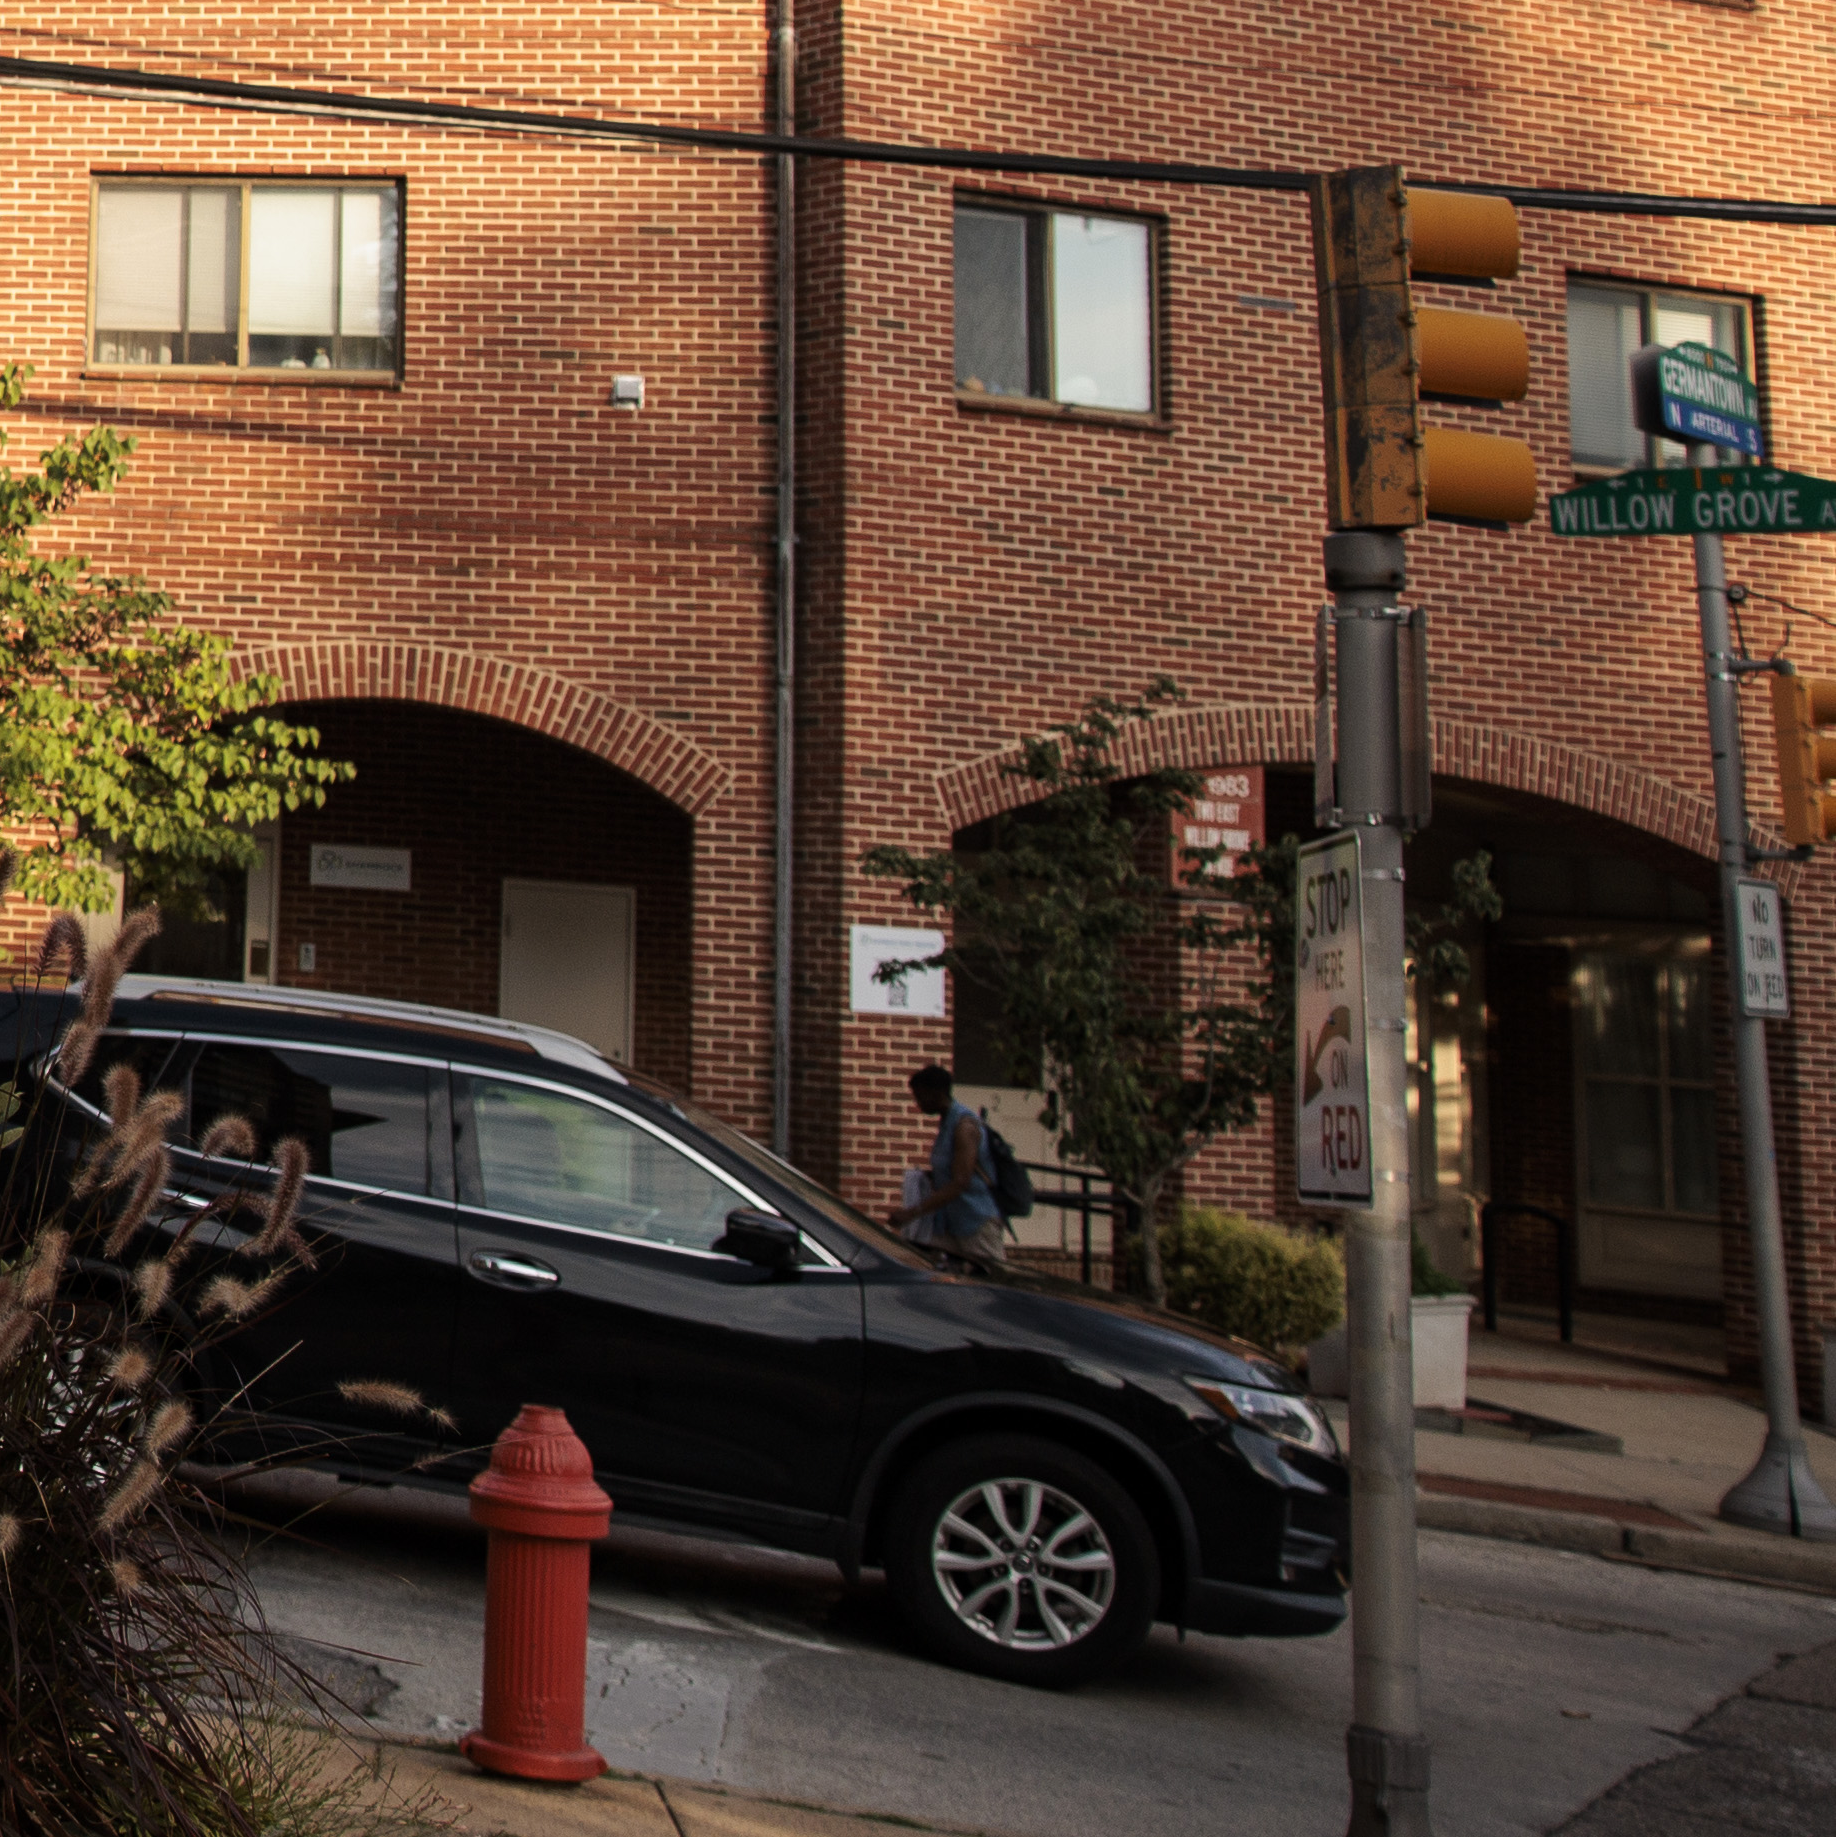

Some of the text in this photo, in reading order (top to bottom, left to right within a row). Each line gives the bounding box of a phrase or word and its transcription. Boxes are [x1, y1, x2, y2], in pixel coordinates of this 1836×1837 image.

[1661, 355, 1745, 416] GERMANTOWN
[1669, 401, 1758, 452] N ARTERIAL S
[1554, 492, 1675, 532] WILLOW
[1691, 489, 1803, 528] GROVE
[1306, 867, 1350, 939] STOP
[1752, 894, 1769, 924] NO
[1749, 935, 1777, 961] TURN
[1315, 949, 1345, 992] HERE
[1747, 972, 1784, 999] ON RED
[1331, 1049, 1349, 1090] ON
[1322, 1105, 1362, 1171] RED
